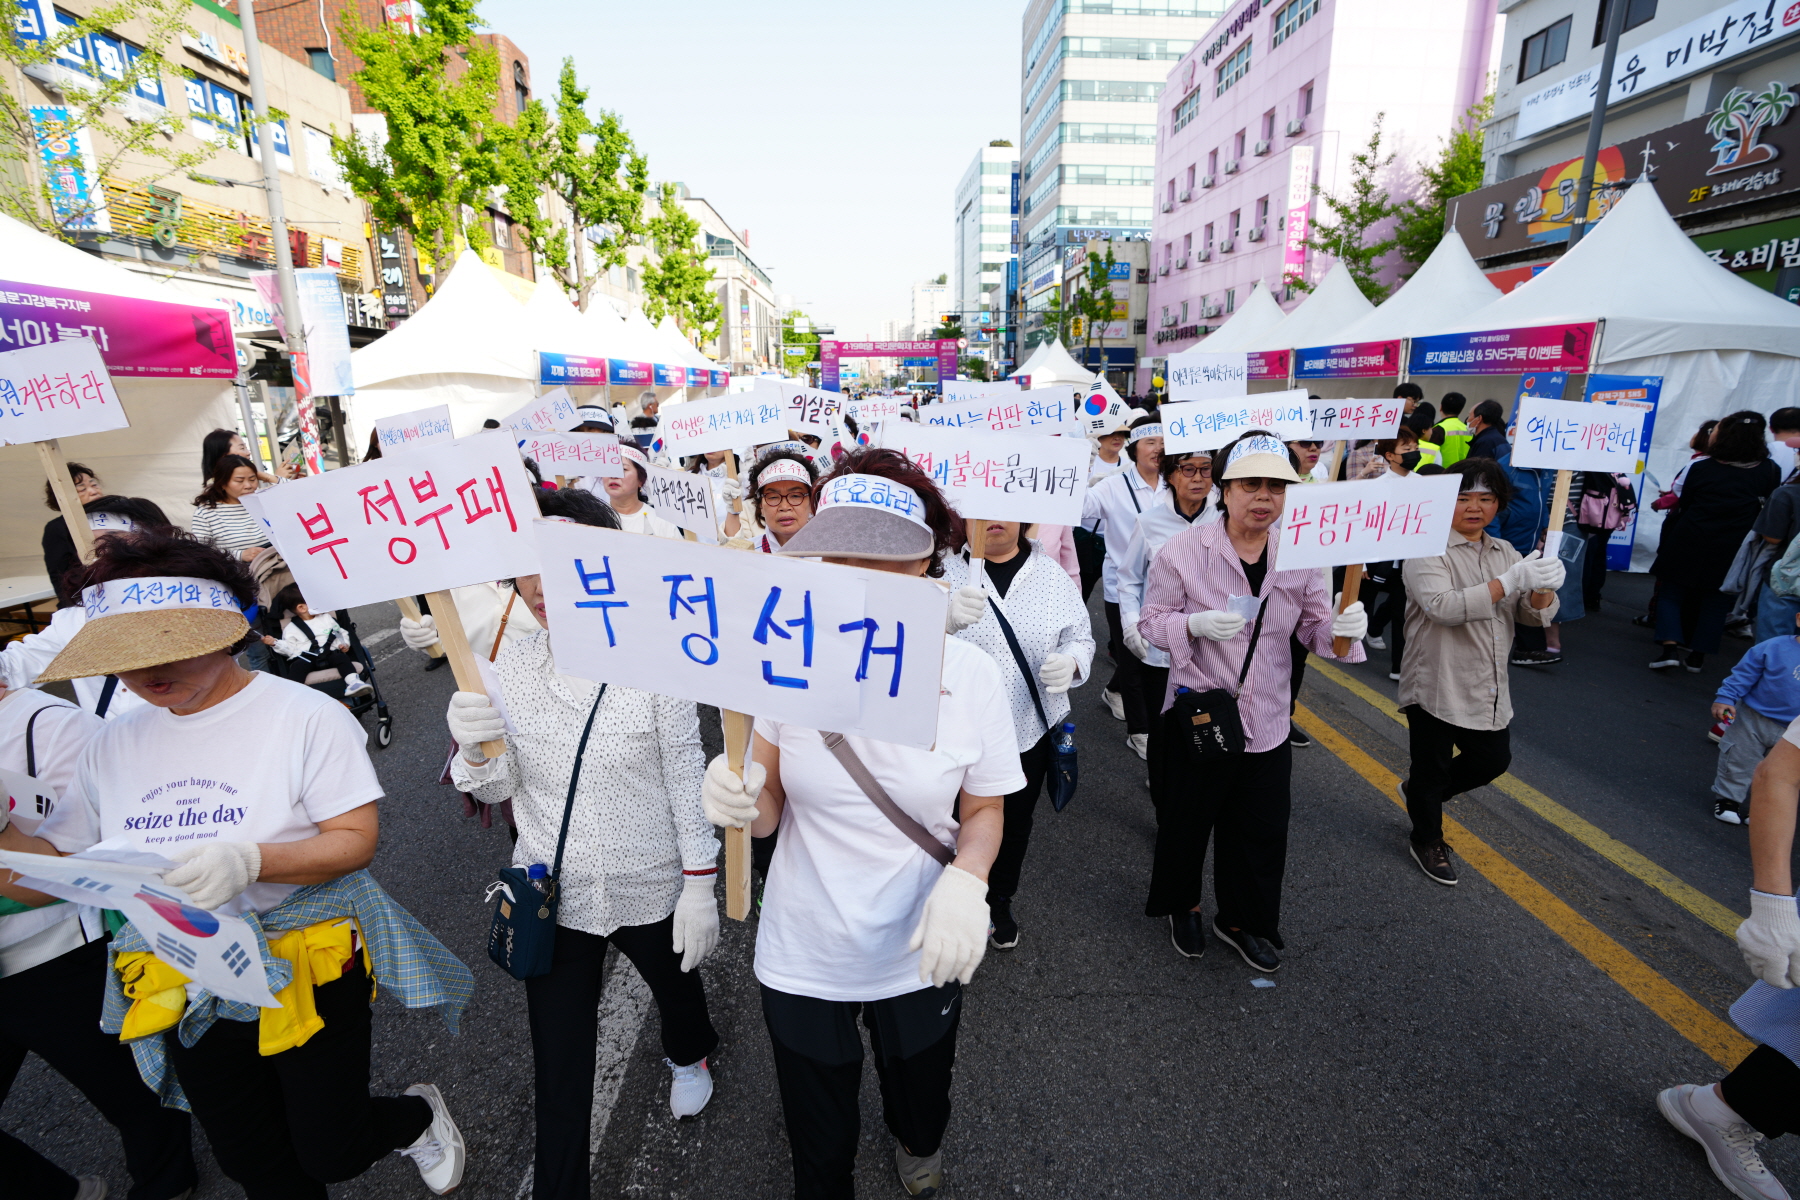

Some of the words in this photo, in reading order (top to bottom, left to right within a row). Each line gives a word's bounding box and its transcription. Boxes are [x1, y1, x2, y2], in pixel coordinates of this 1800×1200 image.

[1687, 186, 1710, 203] 2F
[1711, 168, 1782, 197] 노래연습장
[1481, 179, 1577, 239] 무인도
[1288, 210, 1307, 252] 여성의원
[381, 237, 403, 287] 노래
[385, 294, 407, 305] 연습장
[912, 342, 936, 350] 2024
[1425, 350, 1475, 364] 문자알림신청
[1476, 349, 1483, 361] &
[1484, 346, 1528, 361] SNS구독
[1529, 345, 1563, 360] 이벤트
[1627, 389, 1643, 399] SNS
[828, 477, 920, 516] 무효하라
[120, 581, 202, 605] 자전거와
[574, 555, 904, 698] 부정선거
[141, 785, 163, 804] enjoy
[166, 778, 188, 792] your
[190, 777, 218, 789] happy
[219, 782, 238, 796] time
[176, 797, 201, 806] onset
[124, 811, 173, 831] seize
[178, 807, 208, 827] the
[212, 804, 249, 826] day
[145, 835, 166, 844] keep
[174, 832, 195, 842] good
[196, 830, 218, 839] mood
